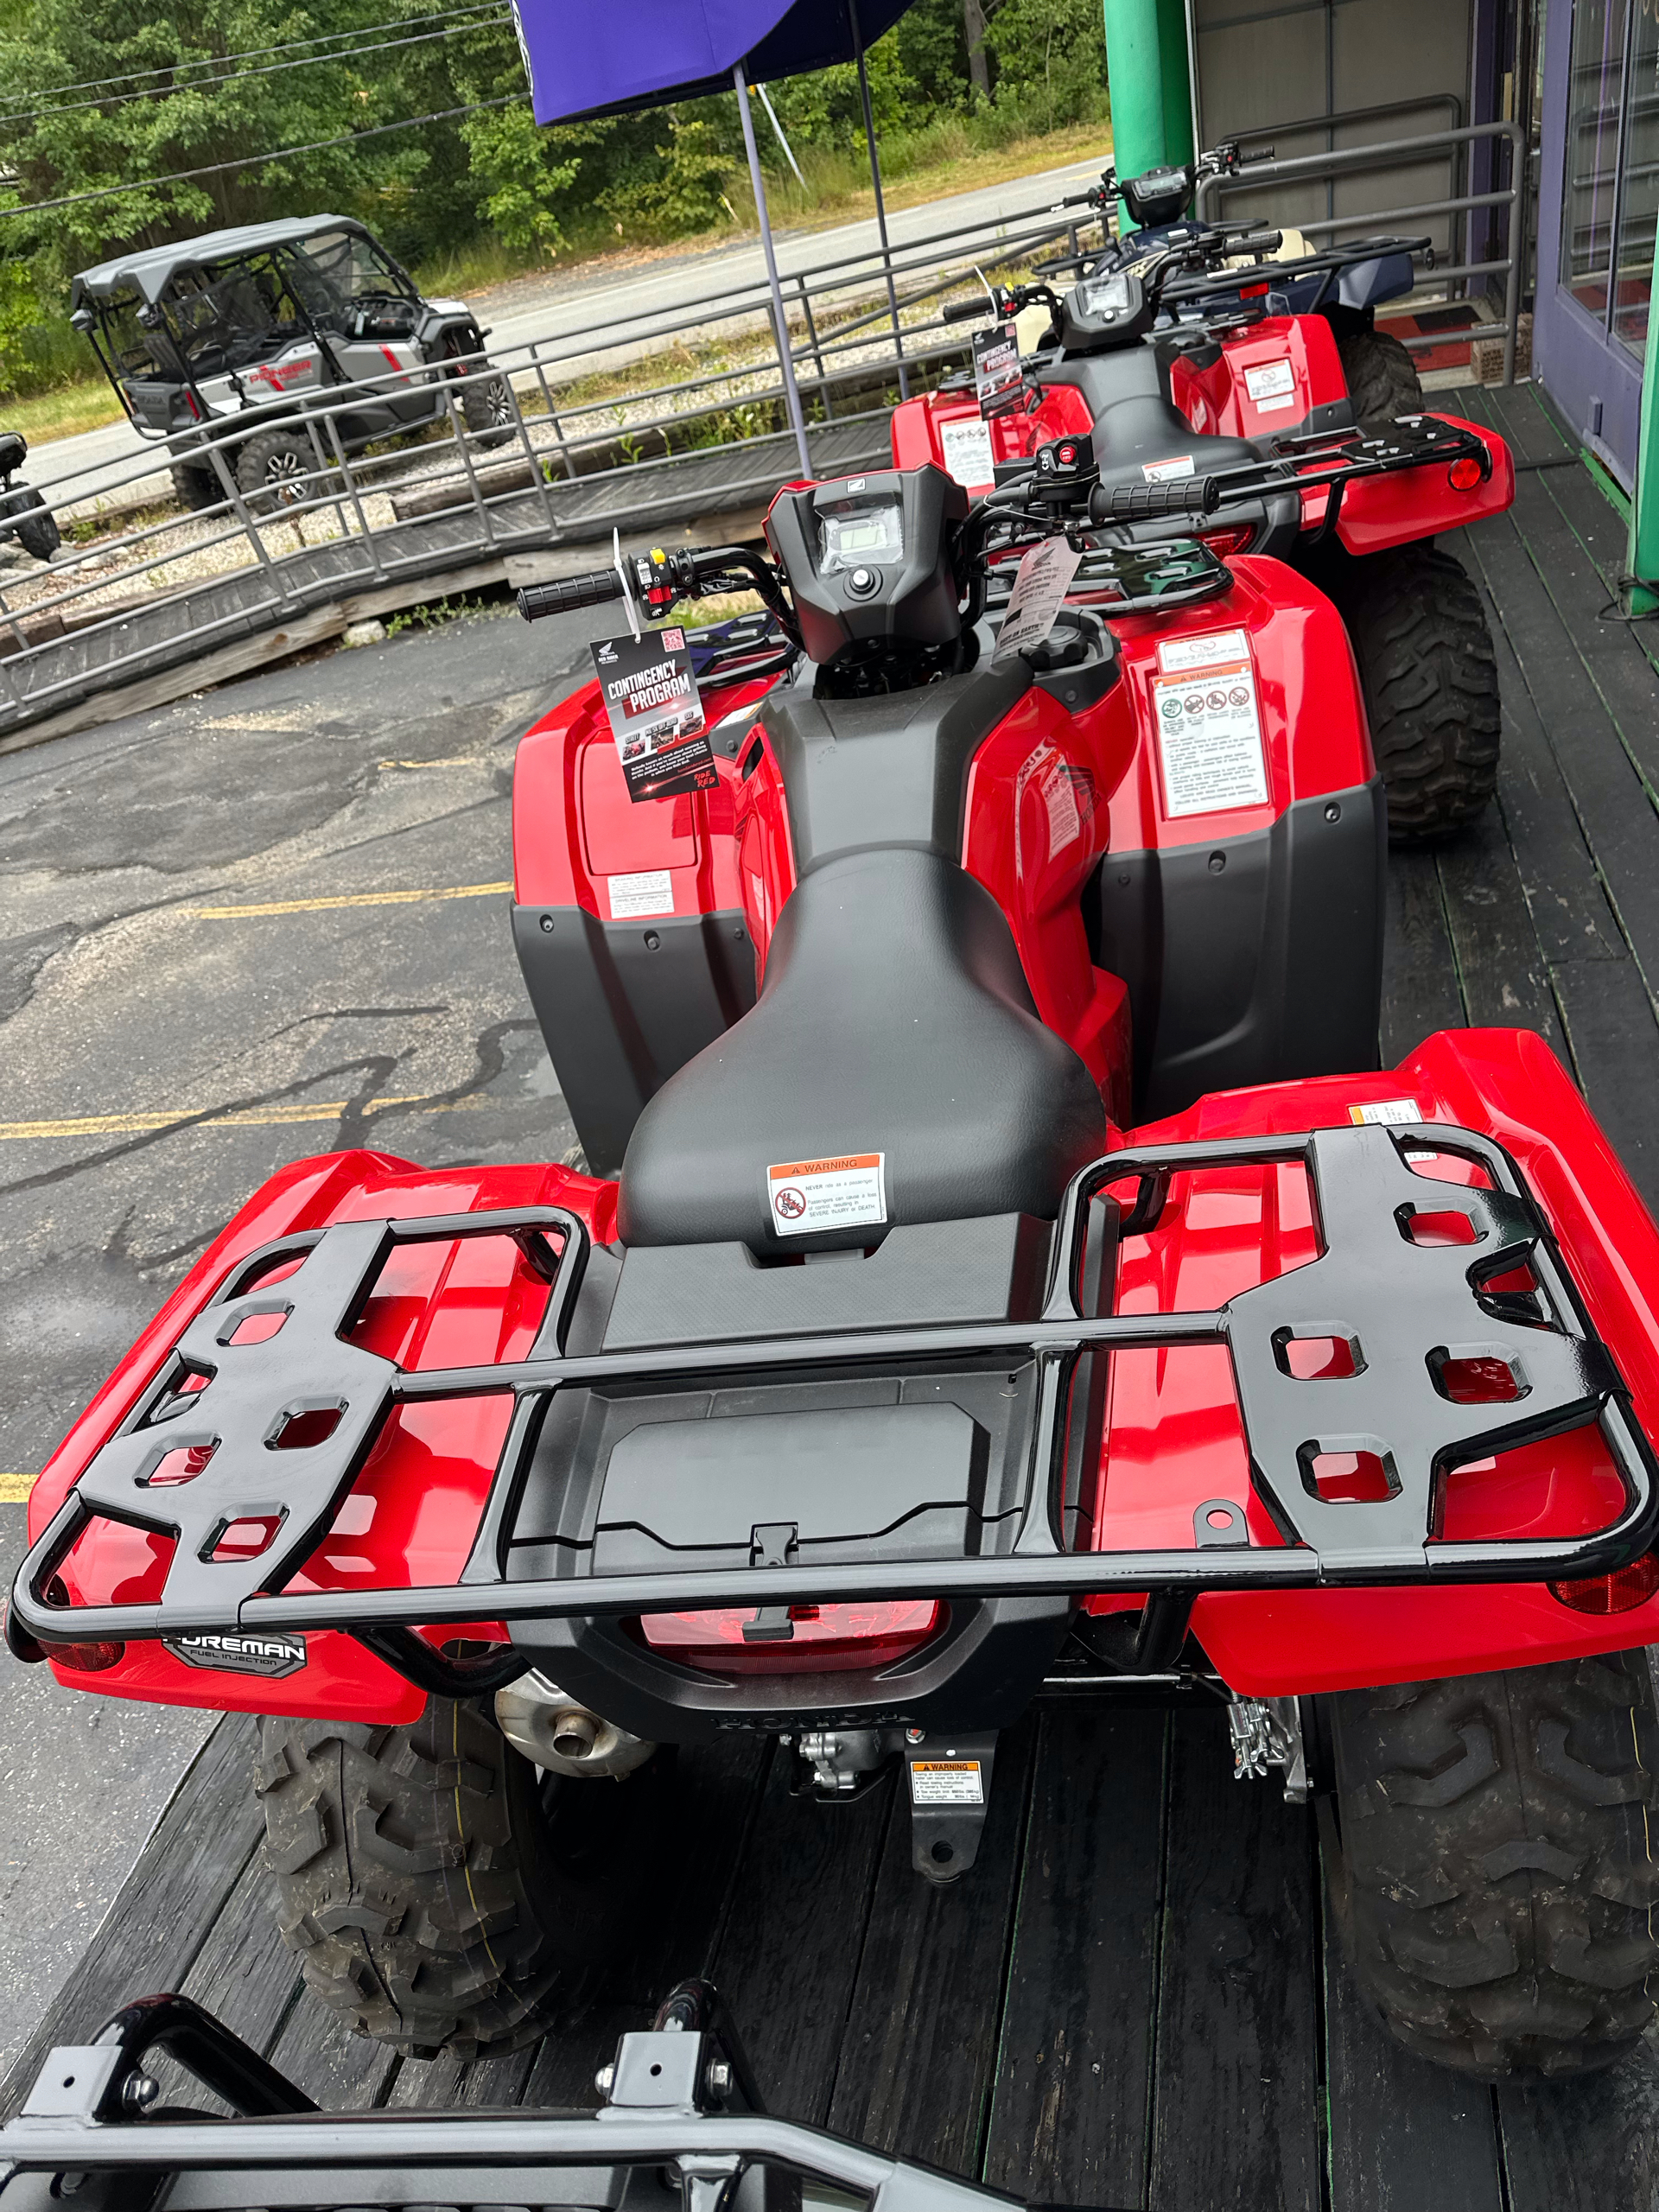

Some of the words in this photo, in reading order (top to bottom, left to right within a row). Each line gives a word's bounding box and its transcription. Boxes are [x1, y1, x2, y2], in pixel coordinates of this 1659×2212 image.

[250, 359, 312, 384] PIONEER
[607, 659, 677, 700] CONTINGENCY
[1190, 669, 1223, 681] WARNING
[630, 673, 691, 713] PROGRAM
[694, 770, 711, 780] RIDE
[697, 776, 715, 788] RED
[805, 1159, 857, 1173] WARNING
[808, 1197, 834, 1206] Passengers
[162, 1636, 305, 1660] OREMAN
[190, 1649, 219, 1659] FUEL
[221, 1653, 277, 1666] INJECTION
[710, 1712, 916, 1730] HONDA
